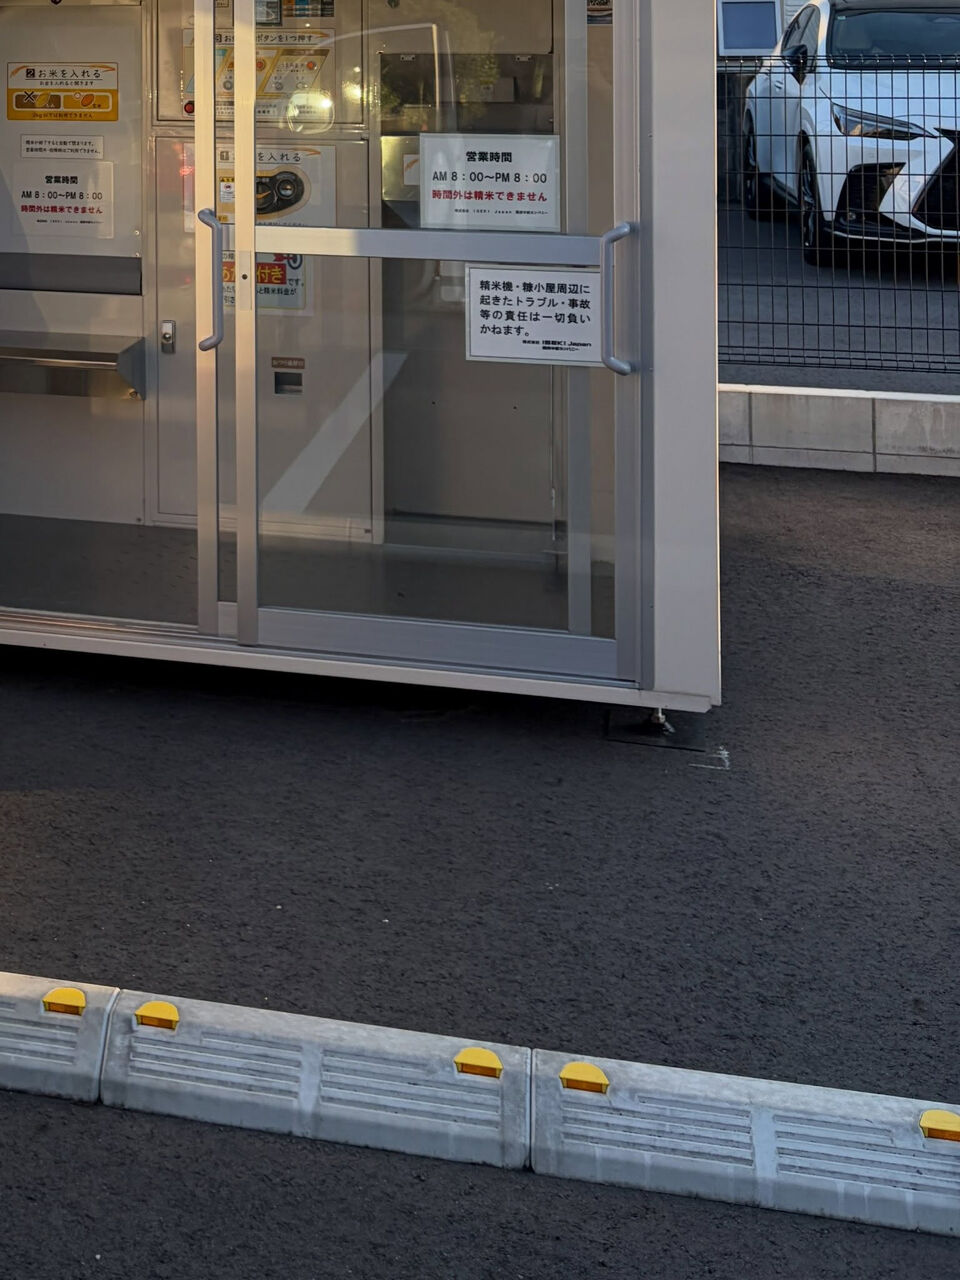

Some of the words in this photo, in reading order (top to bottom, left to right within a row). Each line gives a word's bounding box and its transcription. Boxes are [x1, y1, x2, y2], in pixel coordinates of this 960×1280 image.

[38, 68, 101, 79] お米を入れる
[466, 151, 513, 163] 営業時間
[44, 175, 79, 185] 営業時間
[432, 171, 448, 181] AM
[21, 190, 32, 199] AM
[431, 189, 548, 202] 時間外は精米できません
[20, 204, 104, 214] 時間外は精米できません
[480, 279, 591, 295] 精米機・糠小屋周辺に
[479, 295, 591, 310] 起きたトラブル・事故
[479, 309, 591, 325] 等の責任は一切負い
[480, 324, 530, 337] かねます。
